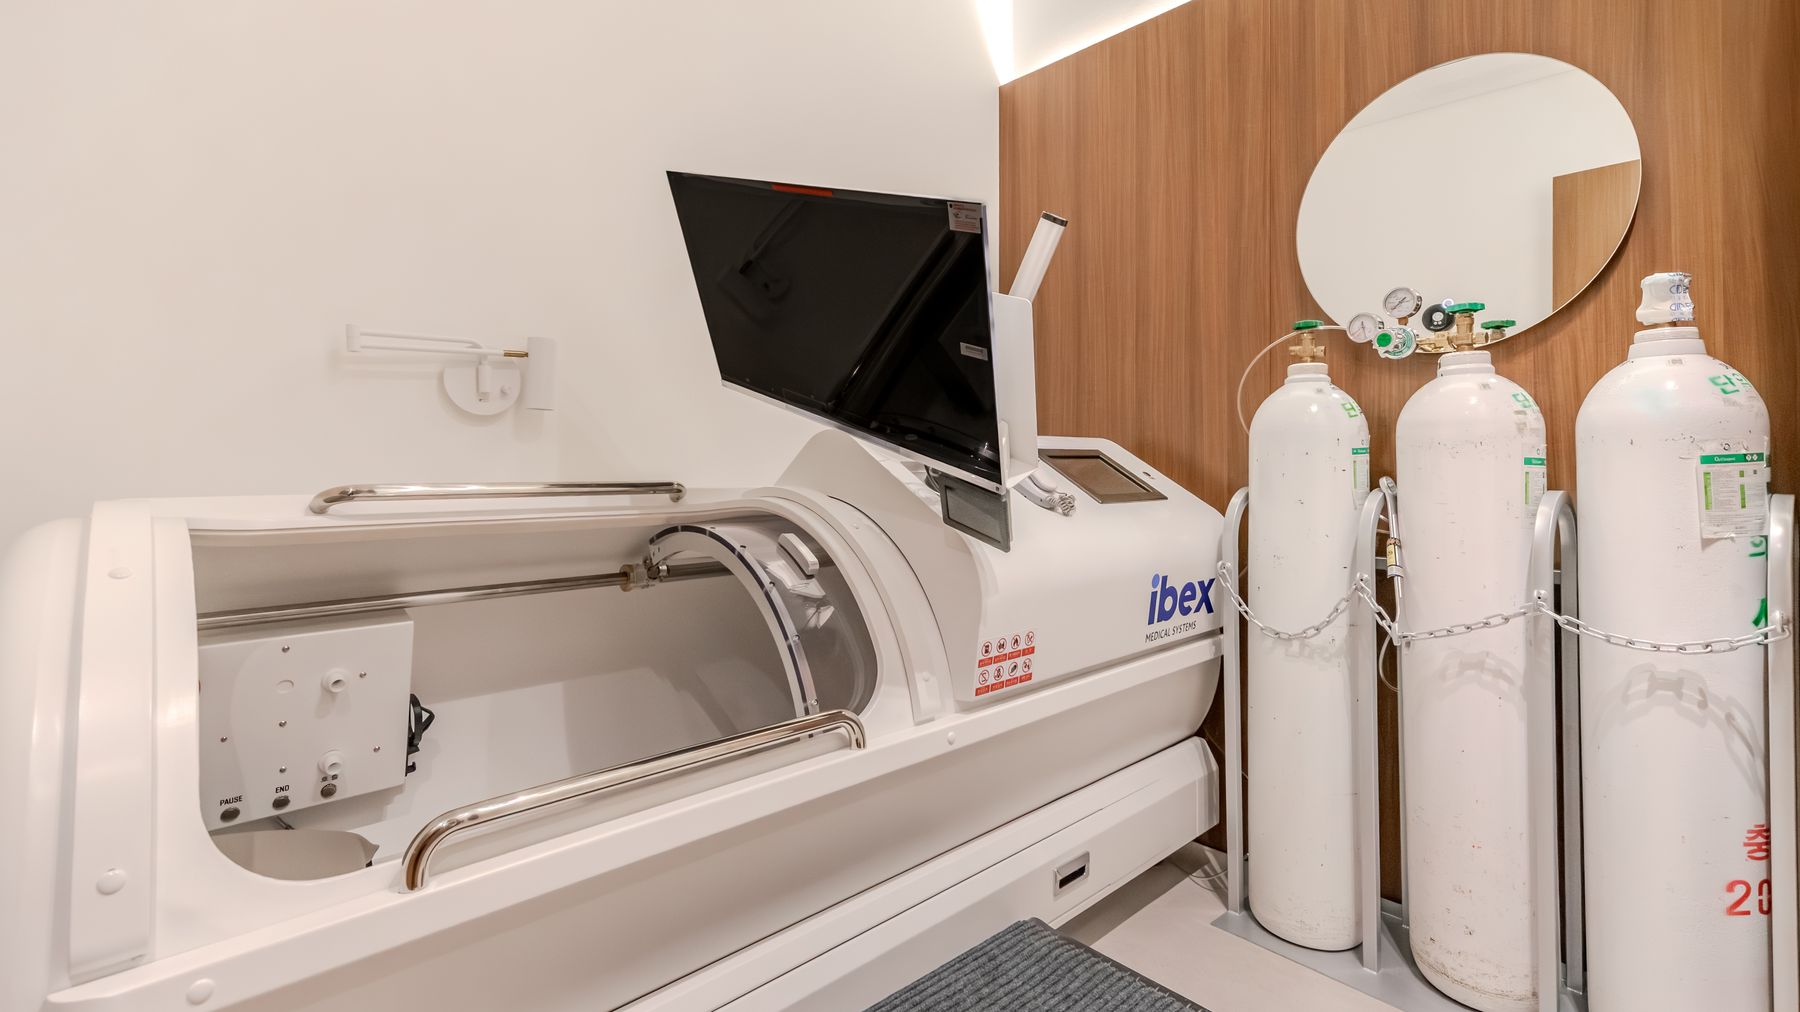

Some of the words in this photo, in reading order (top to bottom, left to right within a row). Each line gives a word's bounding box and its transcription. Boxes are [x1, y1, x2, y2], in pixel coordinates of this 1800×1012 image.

[1148, 573, 1216, 625] ibex
[1145, 628, 1171, 643] MEDICAL
[1172, 620, 1197, 635] SYSTEMS
[275, 785, 290, 793] END
[219, 795, 243, 806] PAUSE
